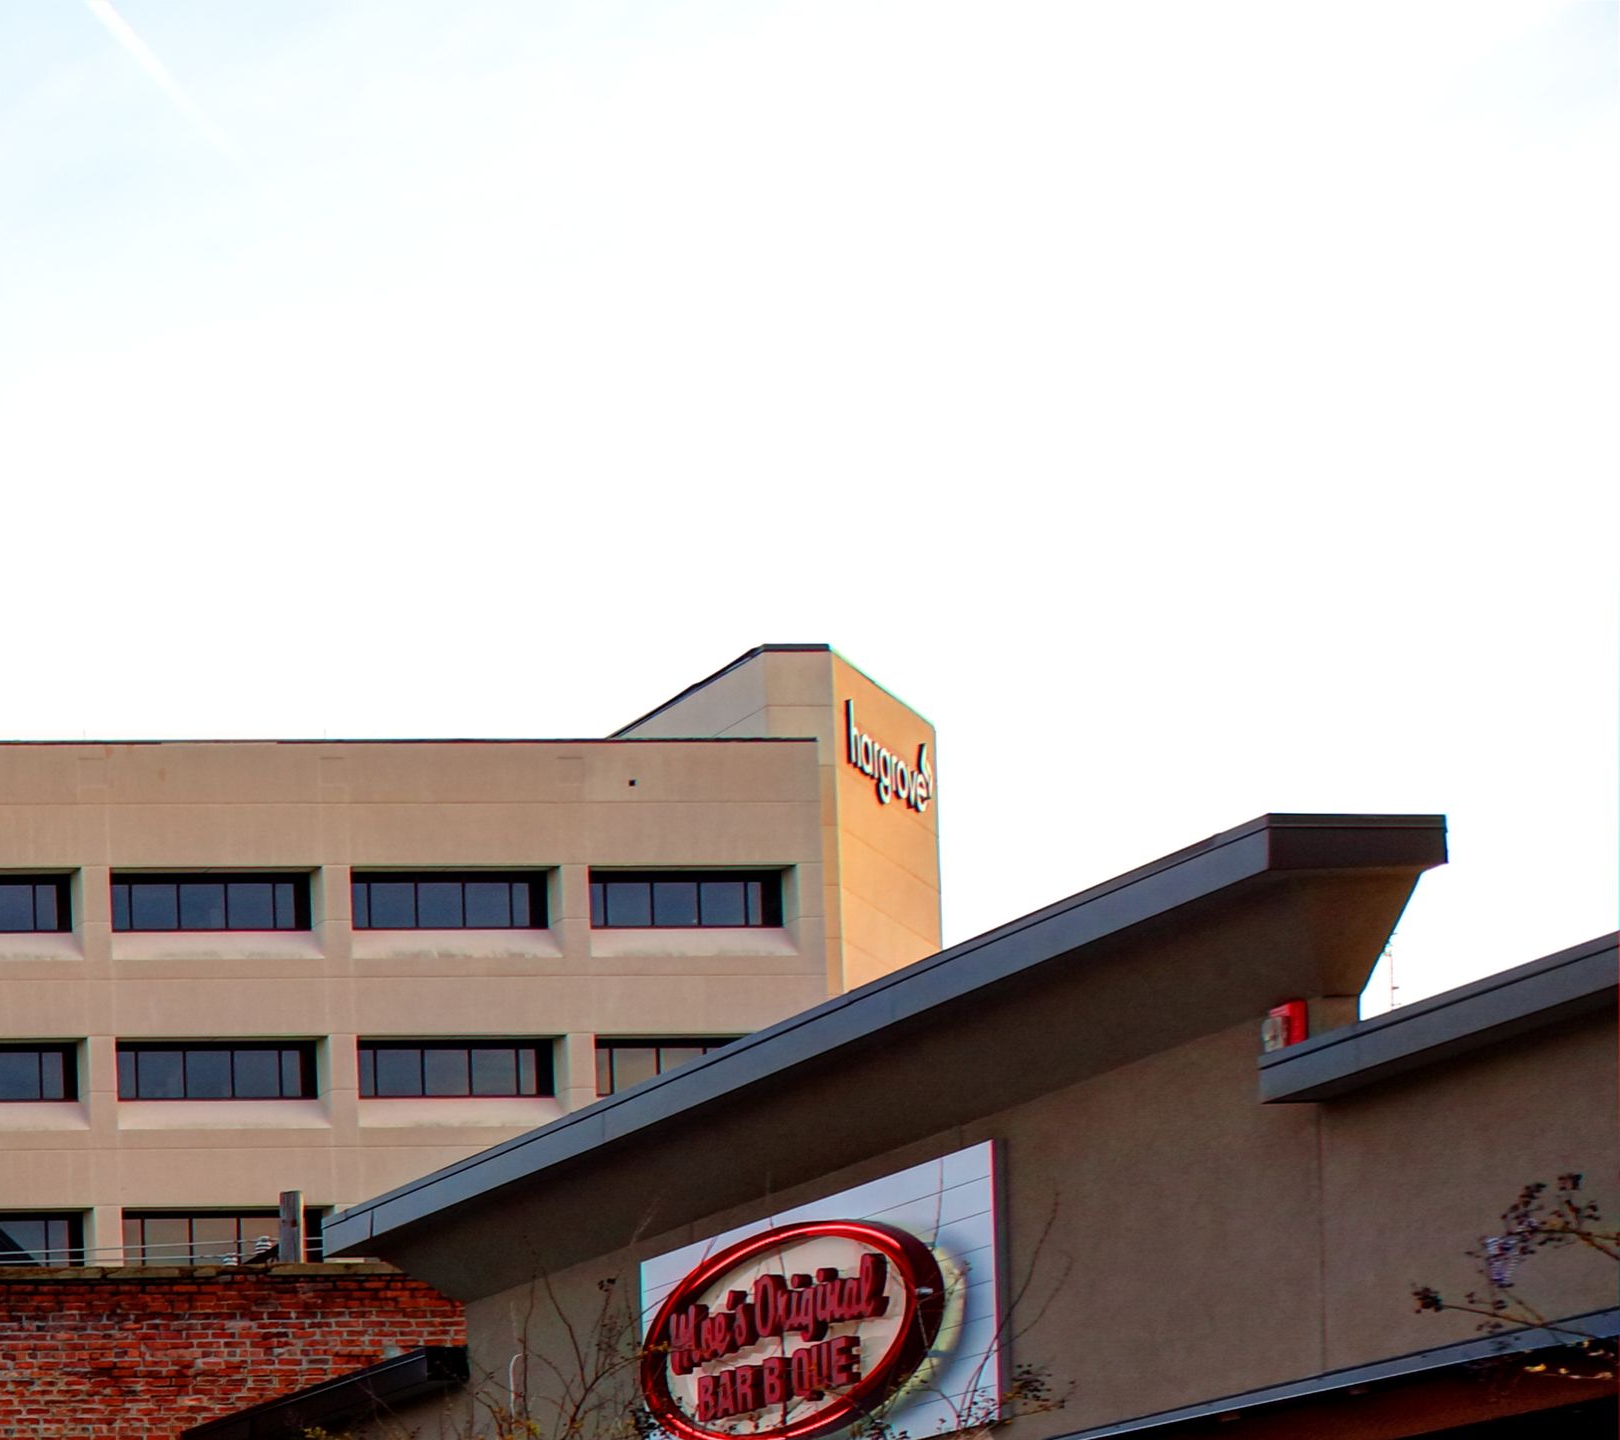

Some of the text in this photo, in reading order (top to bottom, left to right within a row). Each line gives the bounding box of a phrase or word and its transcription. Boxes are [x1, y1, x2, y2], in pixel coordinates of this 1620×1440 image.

[844, 698, 929, 814] hargrove
[669, 1252, 889, 1375] Moe's Original
[697, 1335, 861, 1422] BAR B QUE
